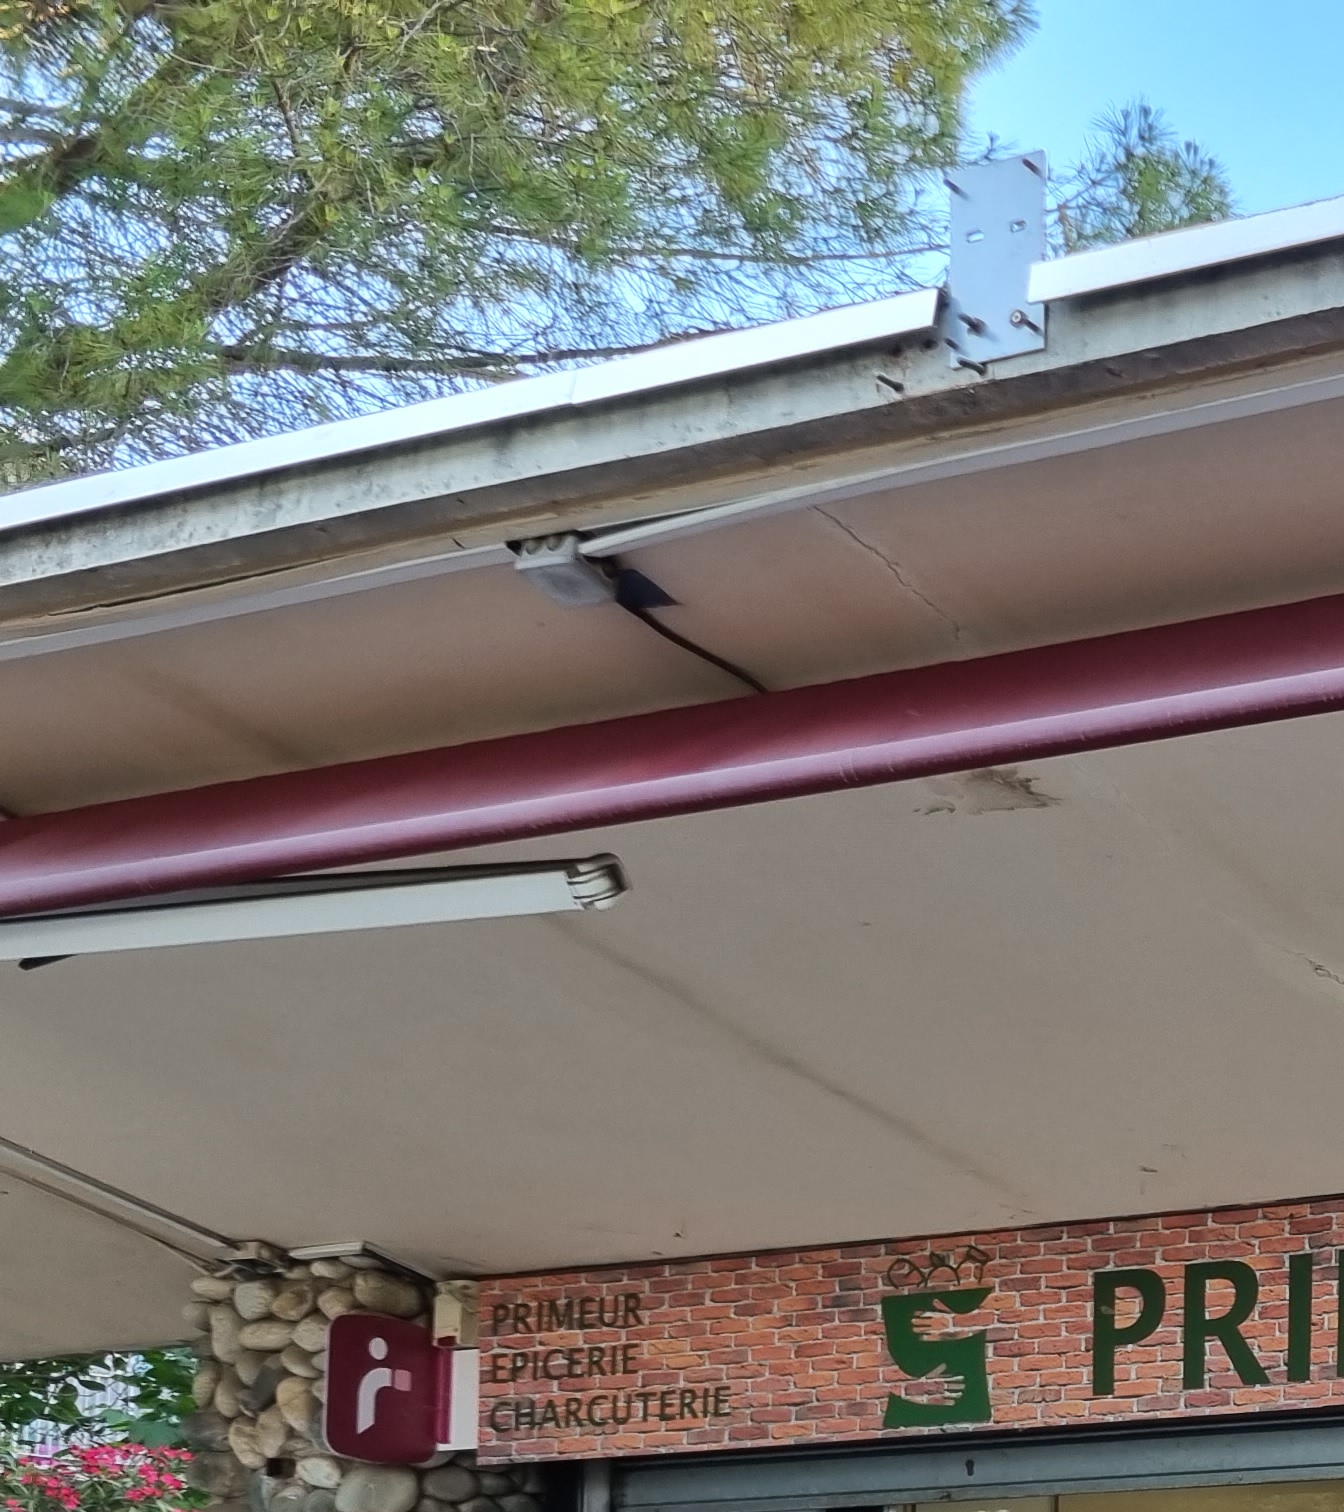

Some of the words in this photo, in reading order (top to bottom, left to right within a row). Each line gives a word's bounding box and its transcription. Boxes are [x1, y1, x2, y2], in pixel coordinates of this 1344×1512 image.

[492, 1291, 644, 1336] PRIMEUR
[491, 1343, 640, 1383] EPICERIE
[490, 1385, 732, 1433] CHARCUTERIE
